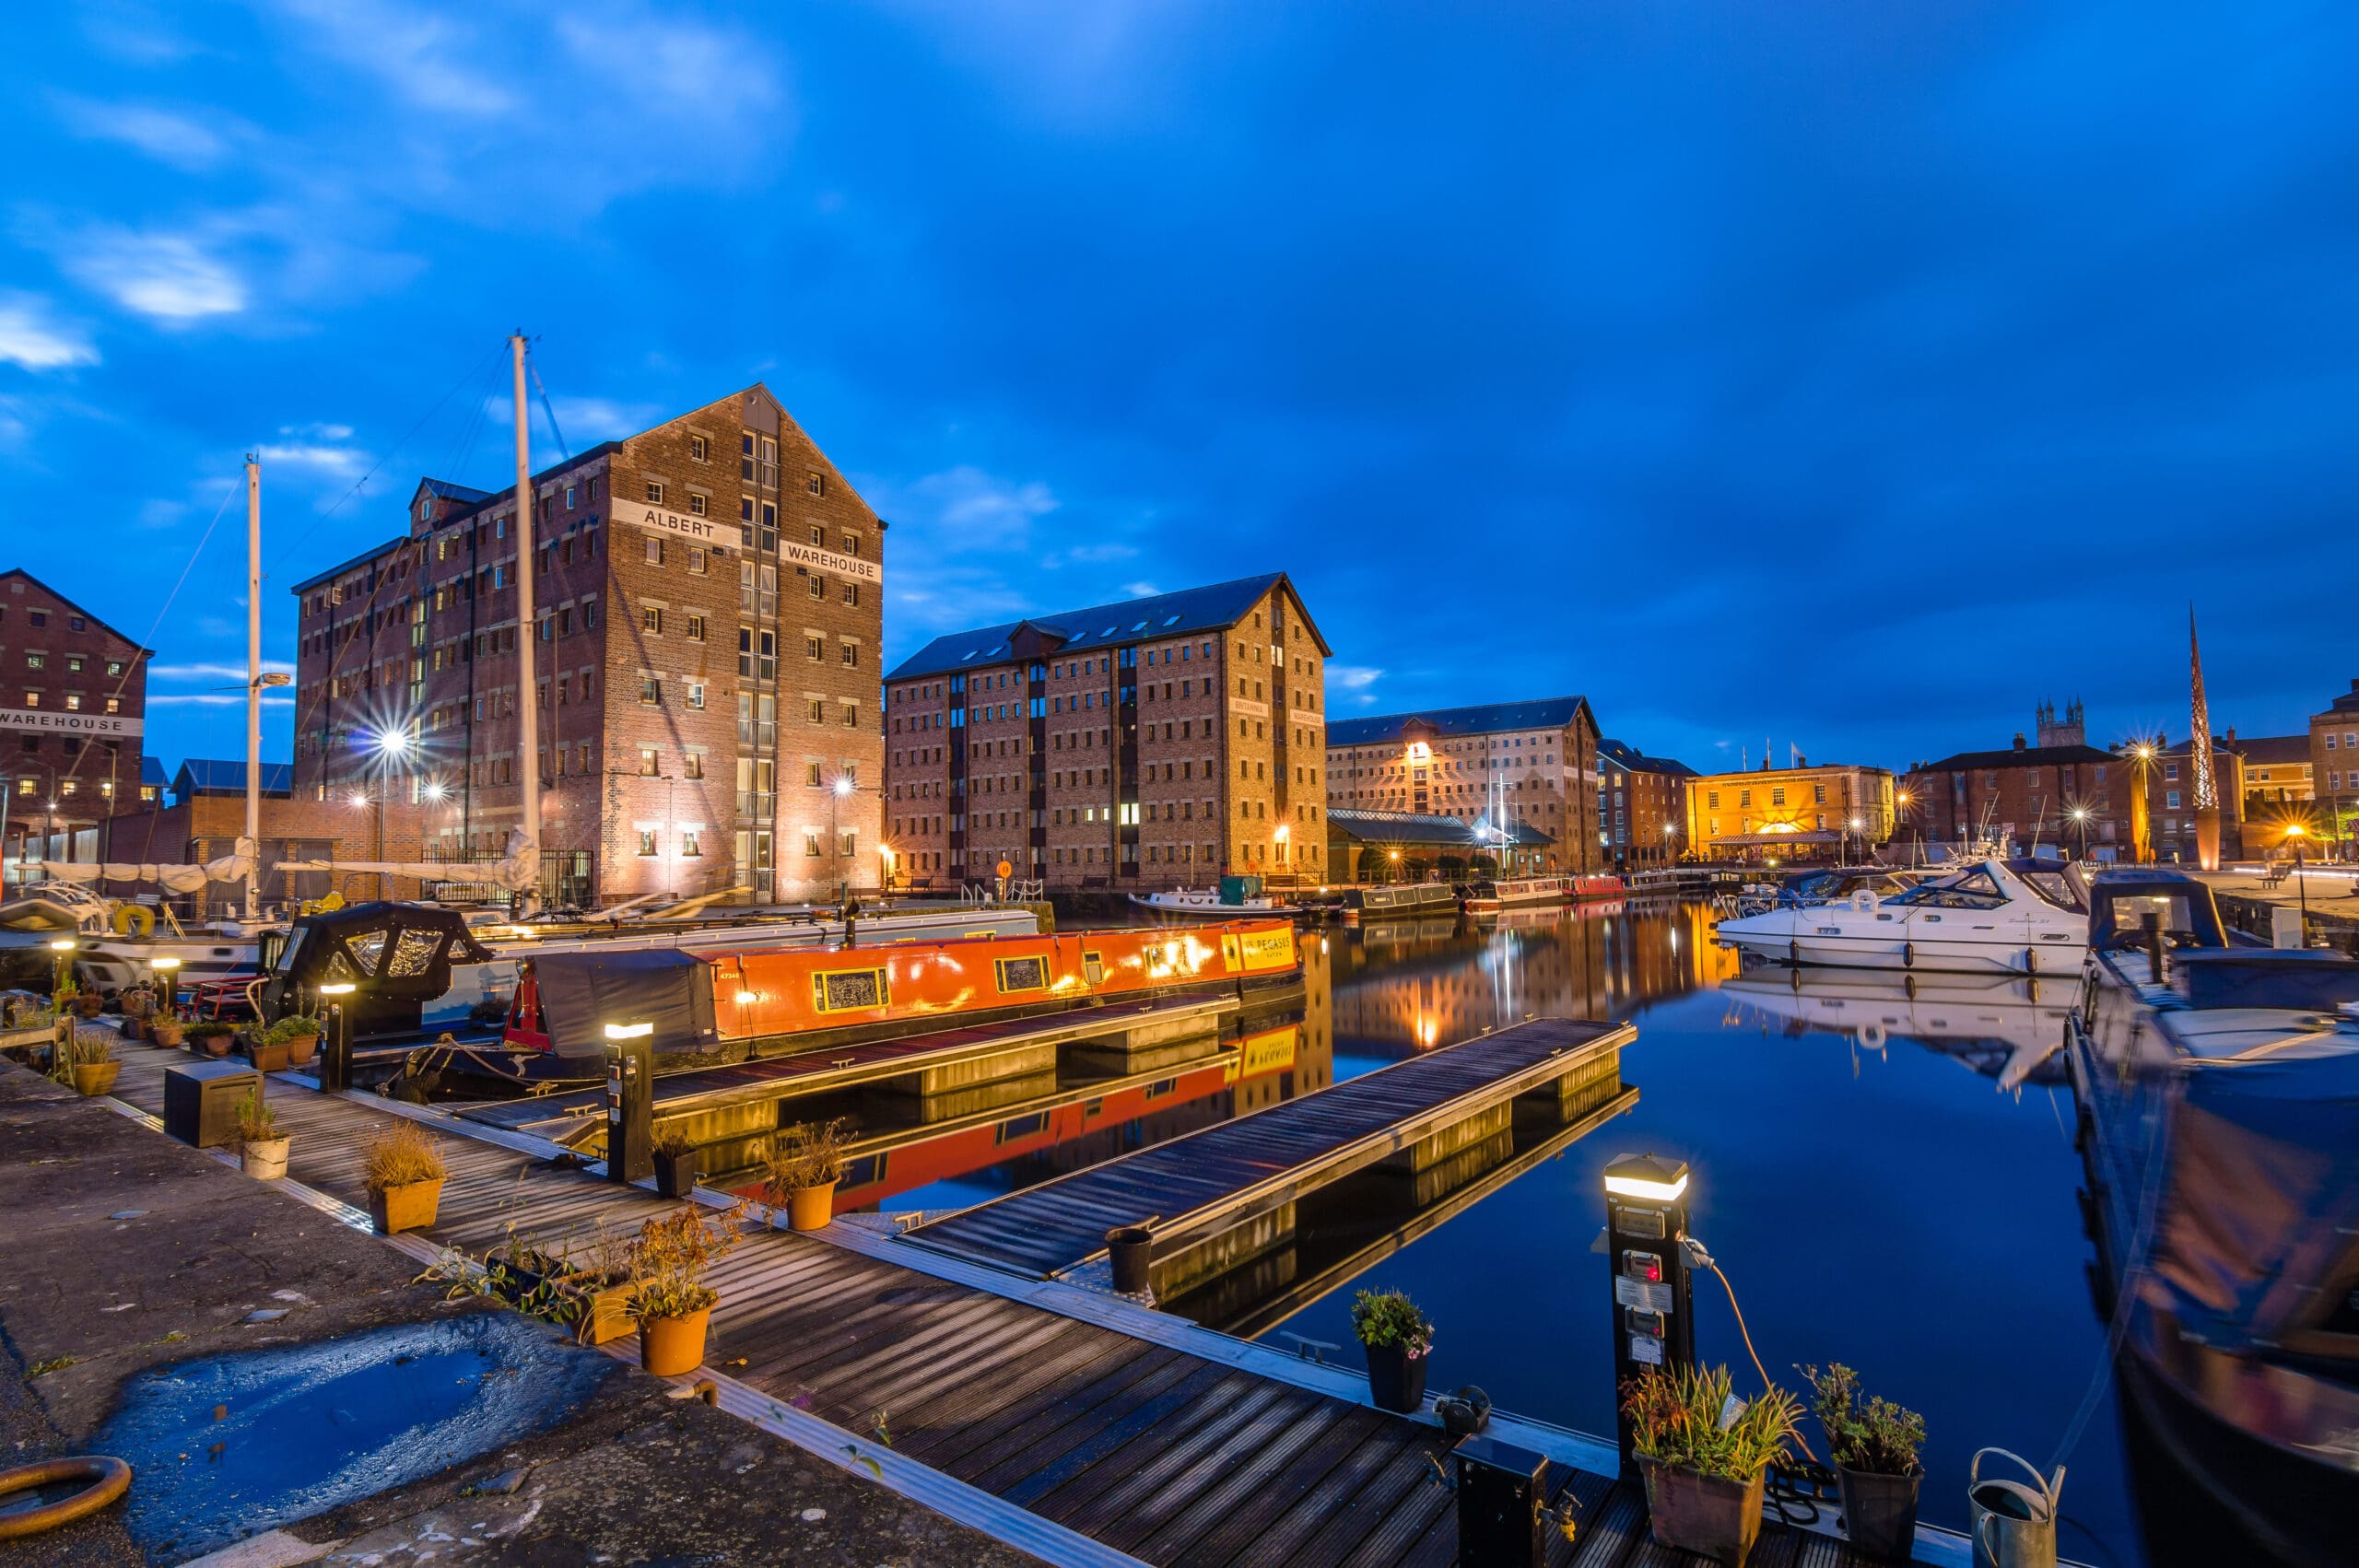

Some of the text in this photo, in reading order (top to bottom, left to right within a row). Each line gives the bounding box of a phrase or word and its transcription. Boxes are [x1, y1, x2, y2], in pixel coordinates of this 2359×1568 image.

[645, 509, 874, 578] ALBERT WAREHOUSE
[1235, 700, 1321, 724] BRITANNIA WAREHOUSE
[1256, 936, 1290, 951] PEGASUS
